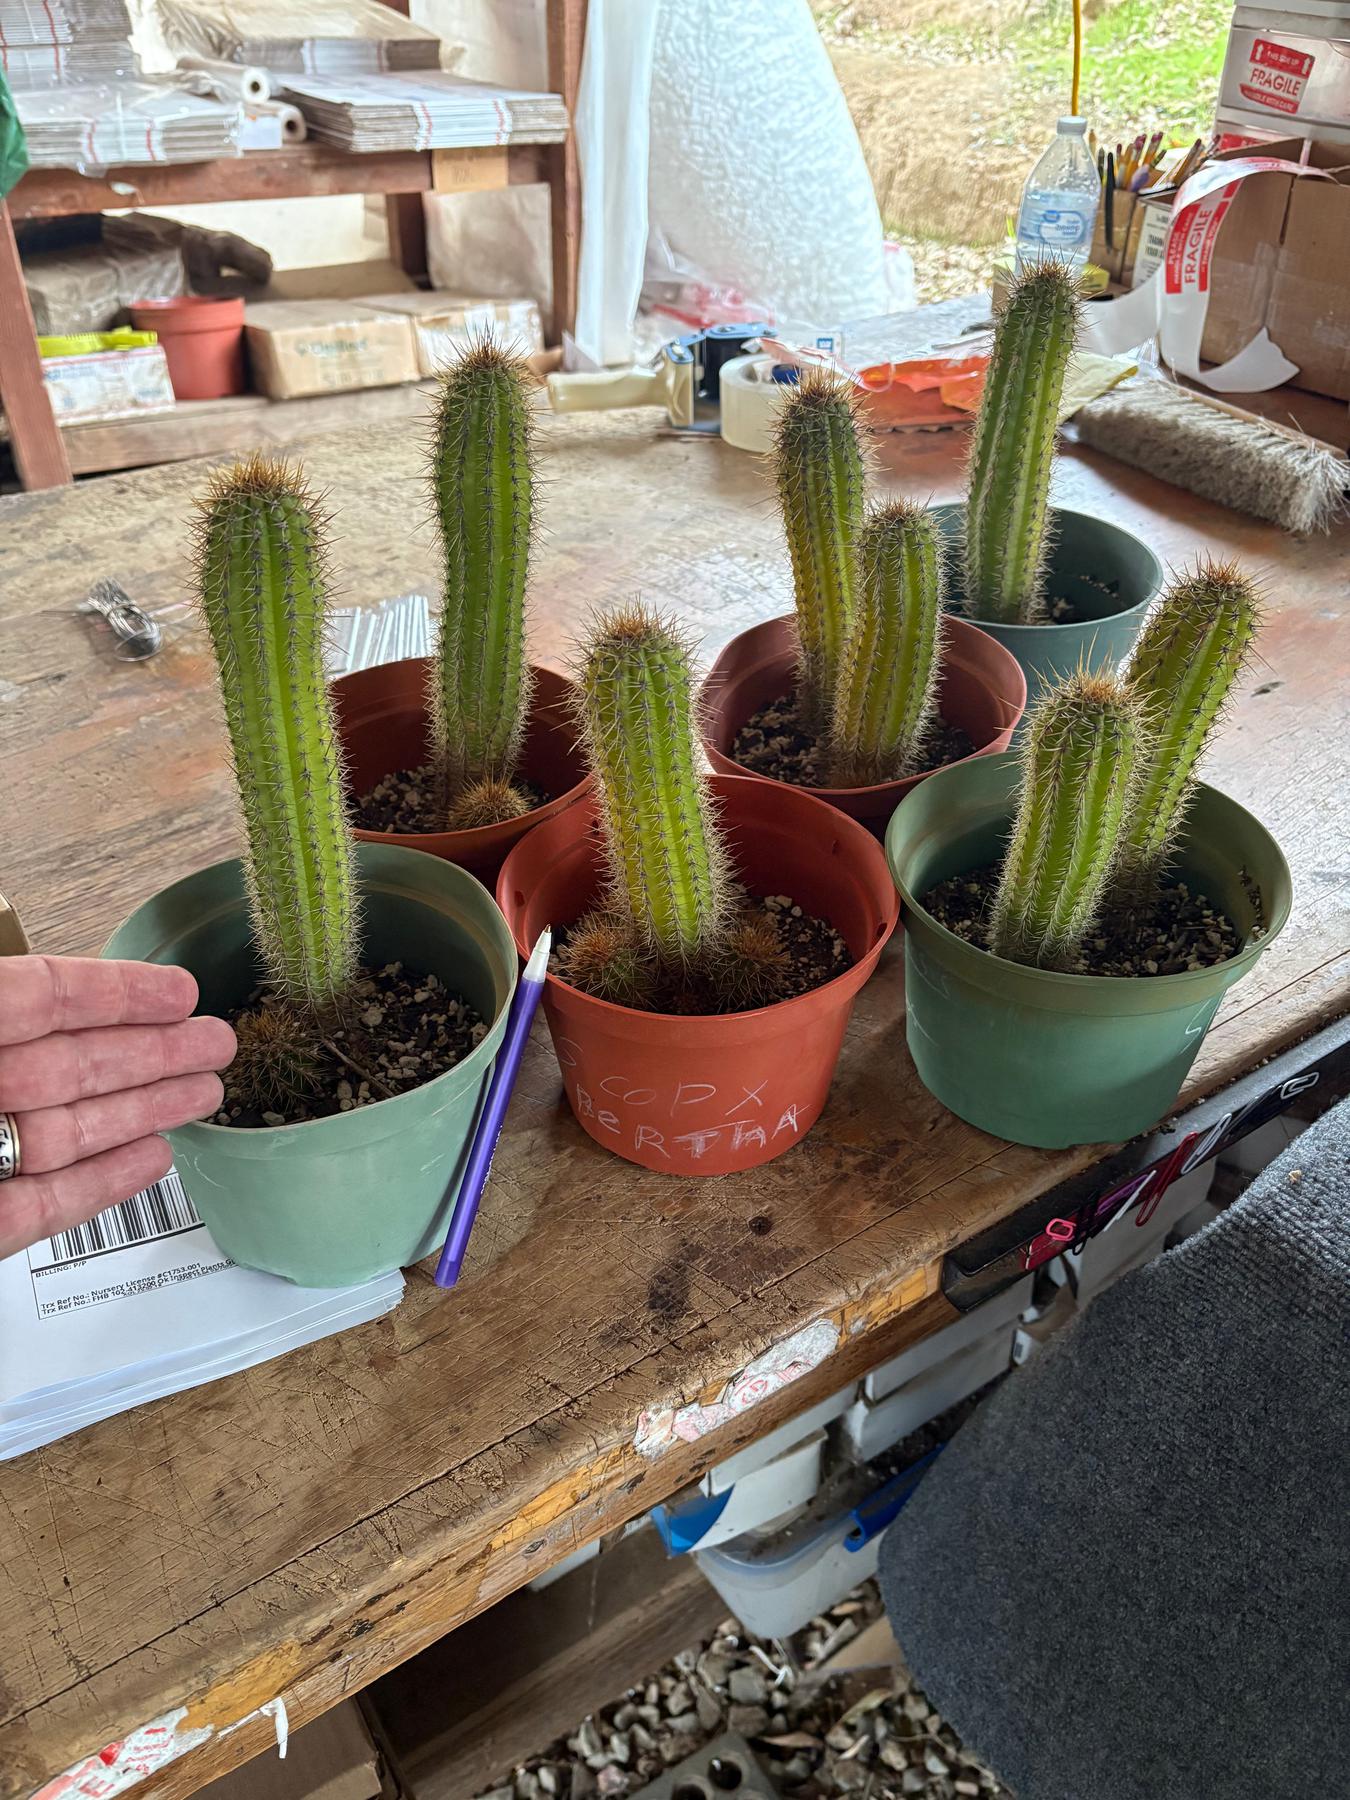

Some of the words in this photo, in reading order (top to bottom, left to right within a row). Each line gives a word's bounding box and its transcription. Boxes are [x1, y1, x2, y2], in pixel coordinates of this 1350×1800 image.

[1249, 67, 1302, 97] FRAGILE
[1184, 208, 1213, 284] FRAGILE
[35, 1265, 72, 1278] BILLING:
[73, 1260, 87, 1268] P/P
[57, 1296, 71, 1305] Ref
[73, 1293, 89, 1301] No.:
[91, 1284, 124, 1297] Nursery
[125, 1275, 156, 1287] License
[157, 1262, 201, 1278] #C1753.001
[58, 1302, 72, 1311] Ref
